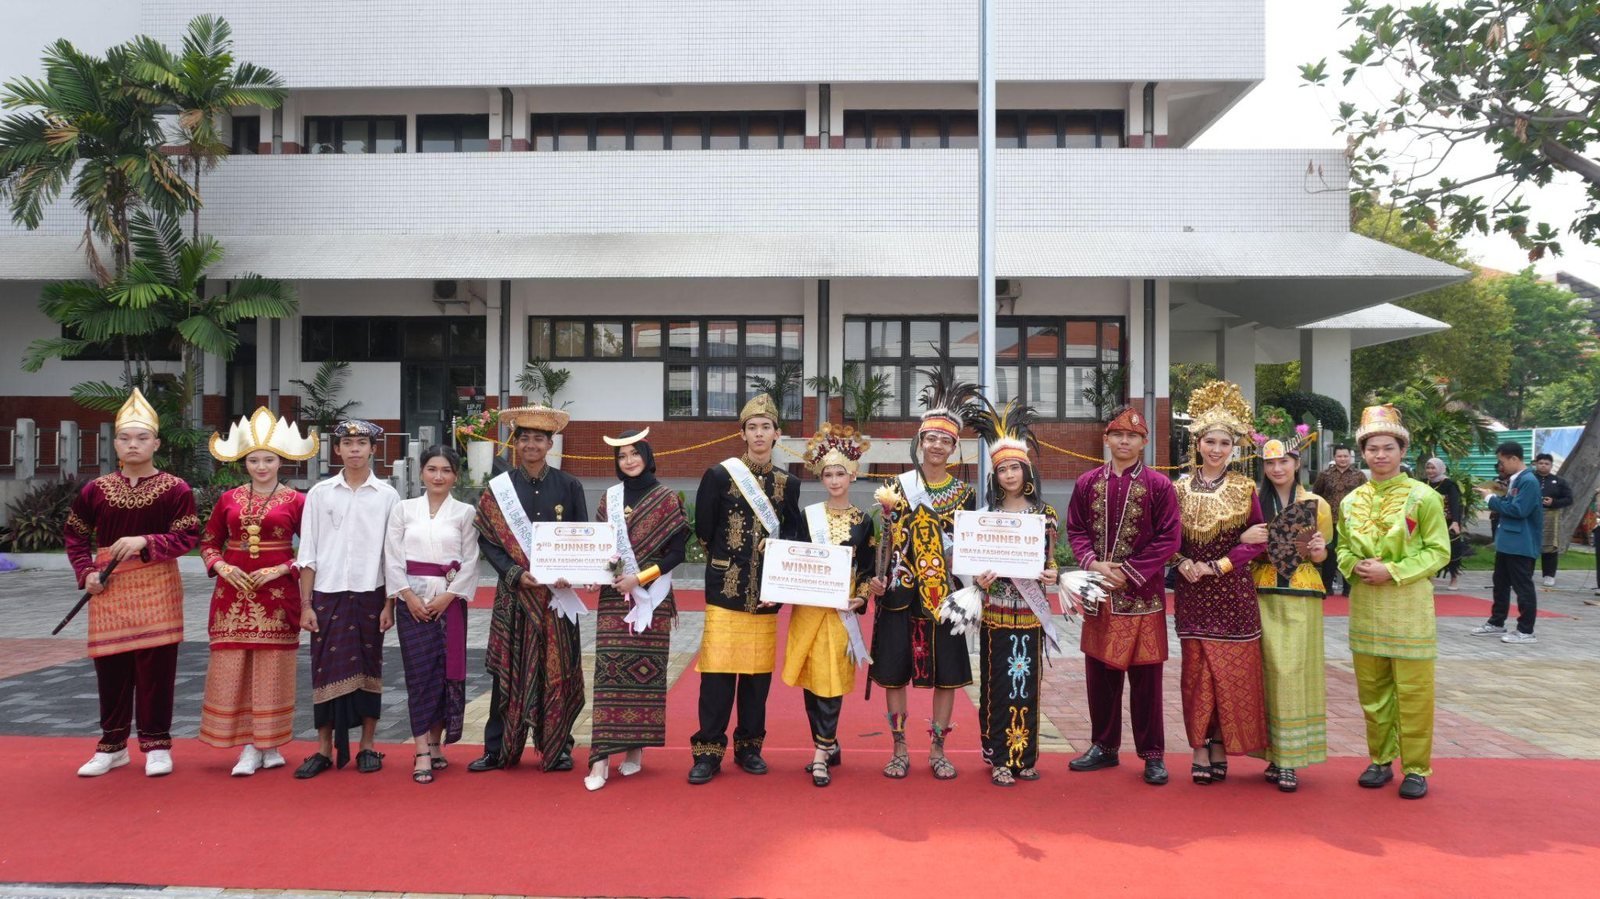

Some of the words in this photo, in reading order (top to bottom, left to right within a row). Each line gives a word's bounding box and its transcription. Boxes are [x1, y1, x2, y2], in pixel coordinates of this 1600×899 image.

[518, 525, 533, 548] FASHIO
[961, 532, 974, 541] 1ST
[977, 533, 1021, 544] RUNNER
[1024, 536, 1039, 545] UP
[536, 542, 552, 552] 2ND
[554, 543, 596, 552] RUNNER
[599, 543, 612, 552] UP
[782, 561, 832, 575] WINNER
[791, 577, 817, 585] FASHION
